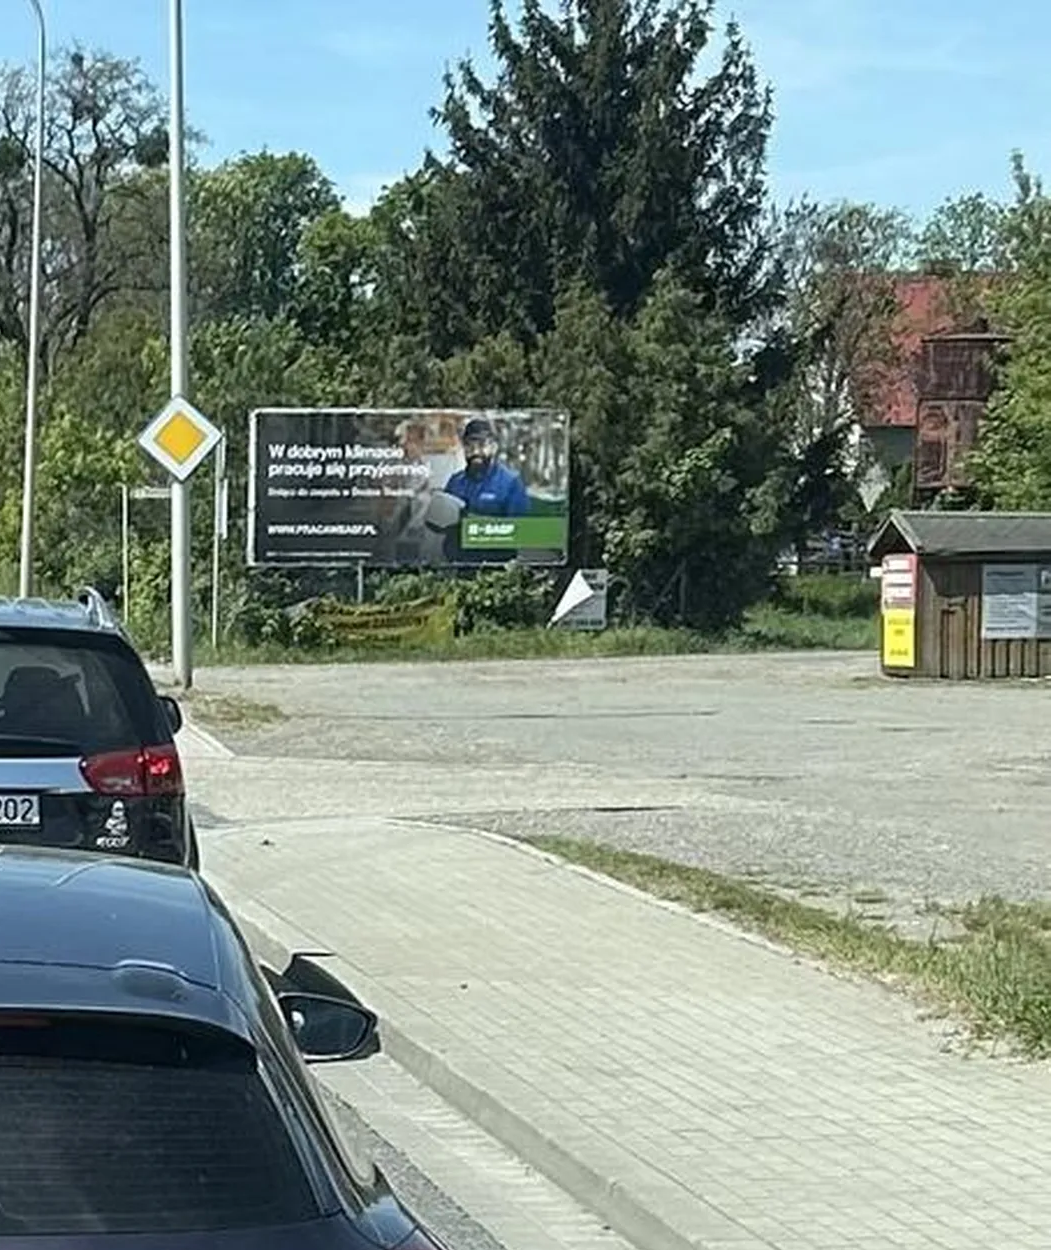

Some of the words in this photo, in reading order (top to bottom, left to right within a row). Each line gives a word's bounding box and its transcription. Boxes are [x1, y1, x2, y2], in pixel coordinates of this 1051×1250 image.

[268, 444, 285, 459] W
[287, 445, 342, 461] dobrym
[345, 445, 404, 459] klimacie
[268, 462, 322, 478] pracuje
[325, 462, 346, 477] się
[349, 462, 430, 478] przyjemniej
